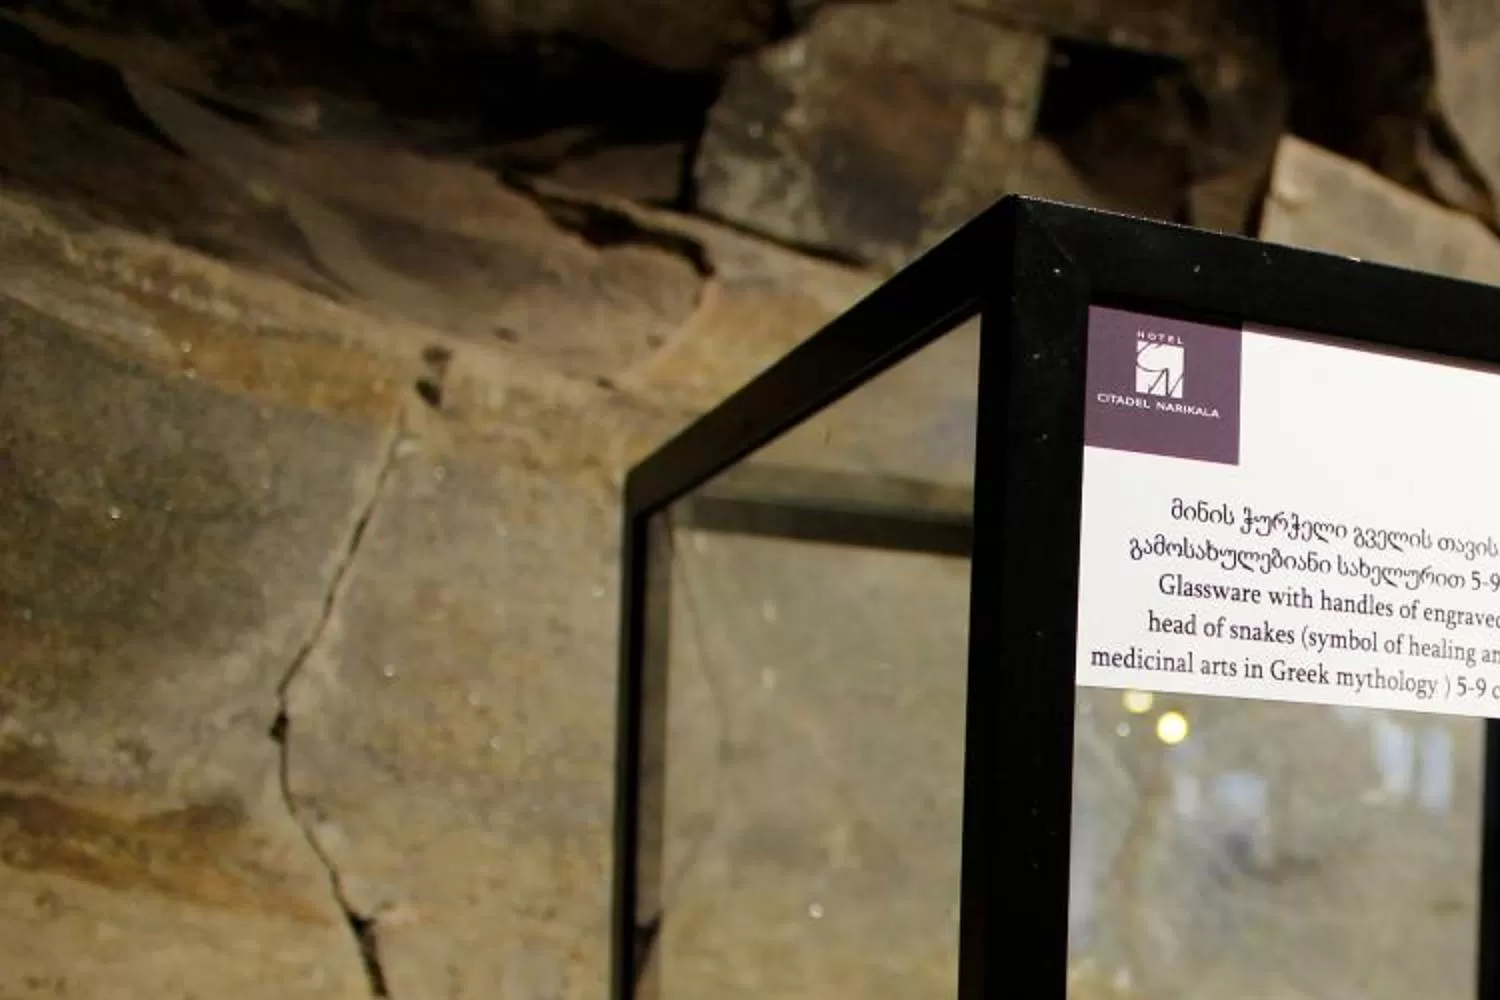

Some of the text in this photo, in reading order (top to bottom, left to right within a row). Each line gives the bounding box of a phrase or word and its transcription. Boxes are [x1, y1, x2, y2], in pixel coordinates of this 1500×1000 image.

[1136, 329, 1184, 345] HOTEL
[1097, 393, 1220, 418] CITADEL NARIKALA
[1171, 497, 1499, 561] მინის ჭურჭელი გველის თავის
[1129, 533, 1332, 574] გამოსახულებიანი
[1337, 554, 1465, 590] სახელურით
[1472, 570, 1500, 592] 5-9
[1159, 573, 1261, 604] Glassware
[1268, 586, 1313, 609] with
[1320, 592, 1393, 617] handles
[1399, 600, 1420, 620] of
[1148, 609, 1197, 636] head
[1203, 616, 1226, 638] of
[1230, 620, 1295, 644] snakes
[1301, 625, 1378, 654] (symbol
[1384, 633, 1404, 654] of
[1409, 634, 1476, 668] healing
[1091, 646, 1193, 673] medicinal
[1200, 660, 1237, 677] arts
[1244, 658, 1264, 679] in
[1270, 659, 1330, 684] Greek
[1336, 668, 1437, 699] mythology
[1457, 676, 1487, 698] 5-9
